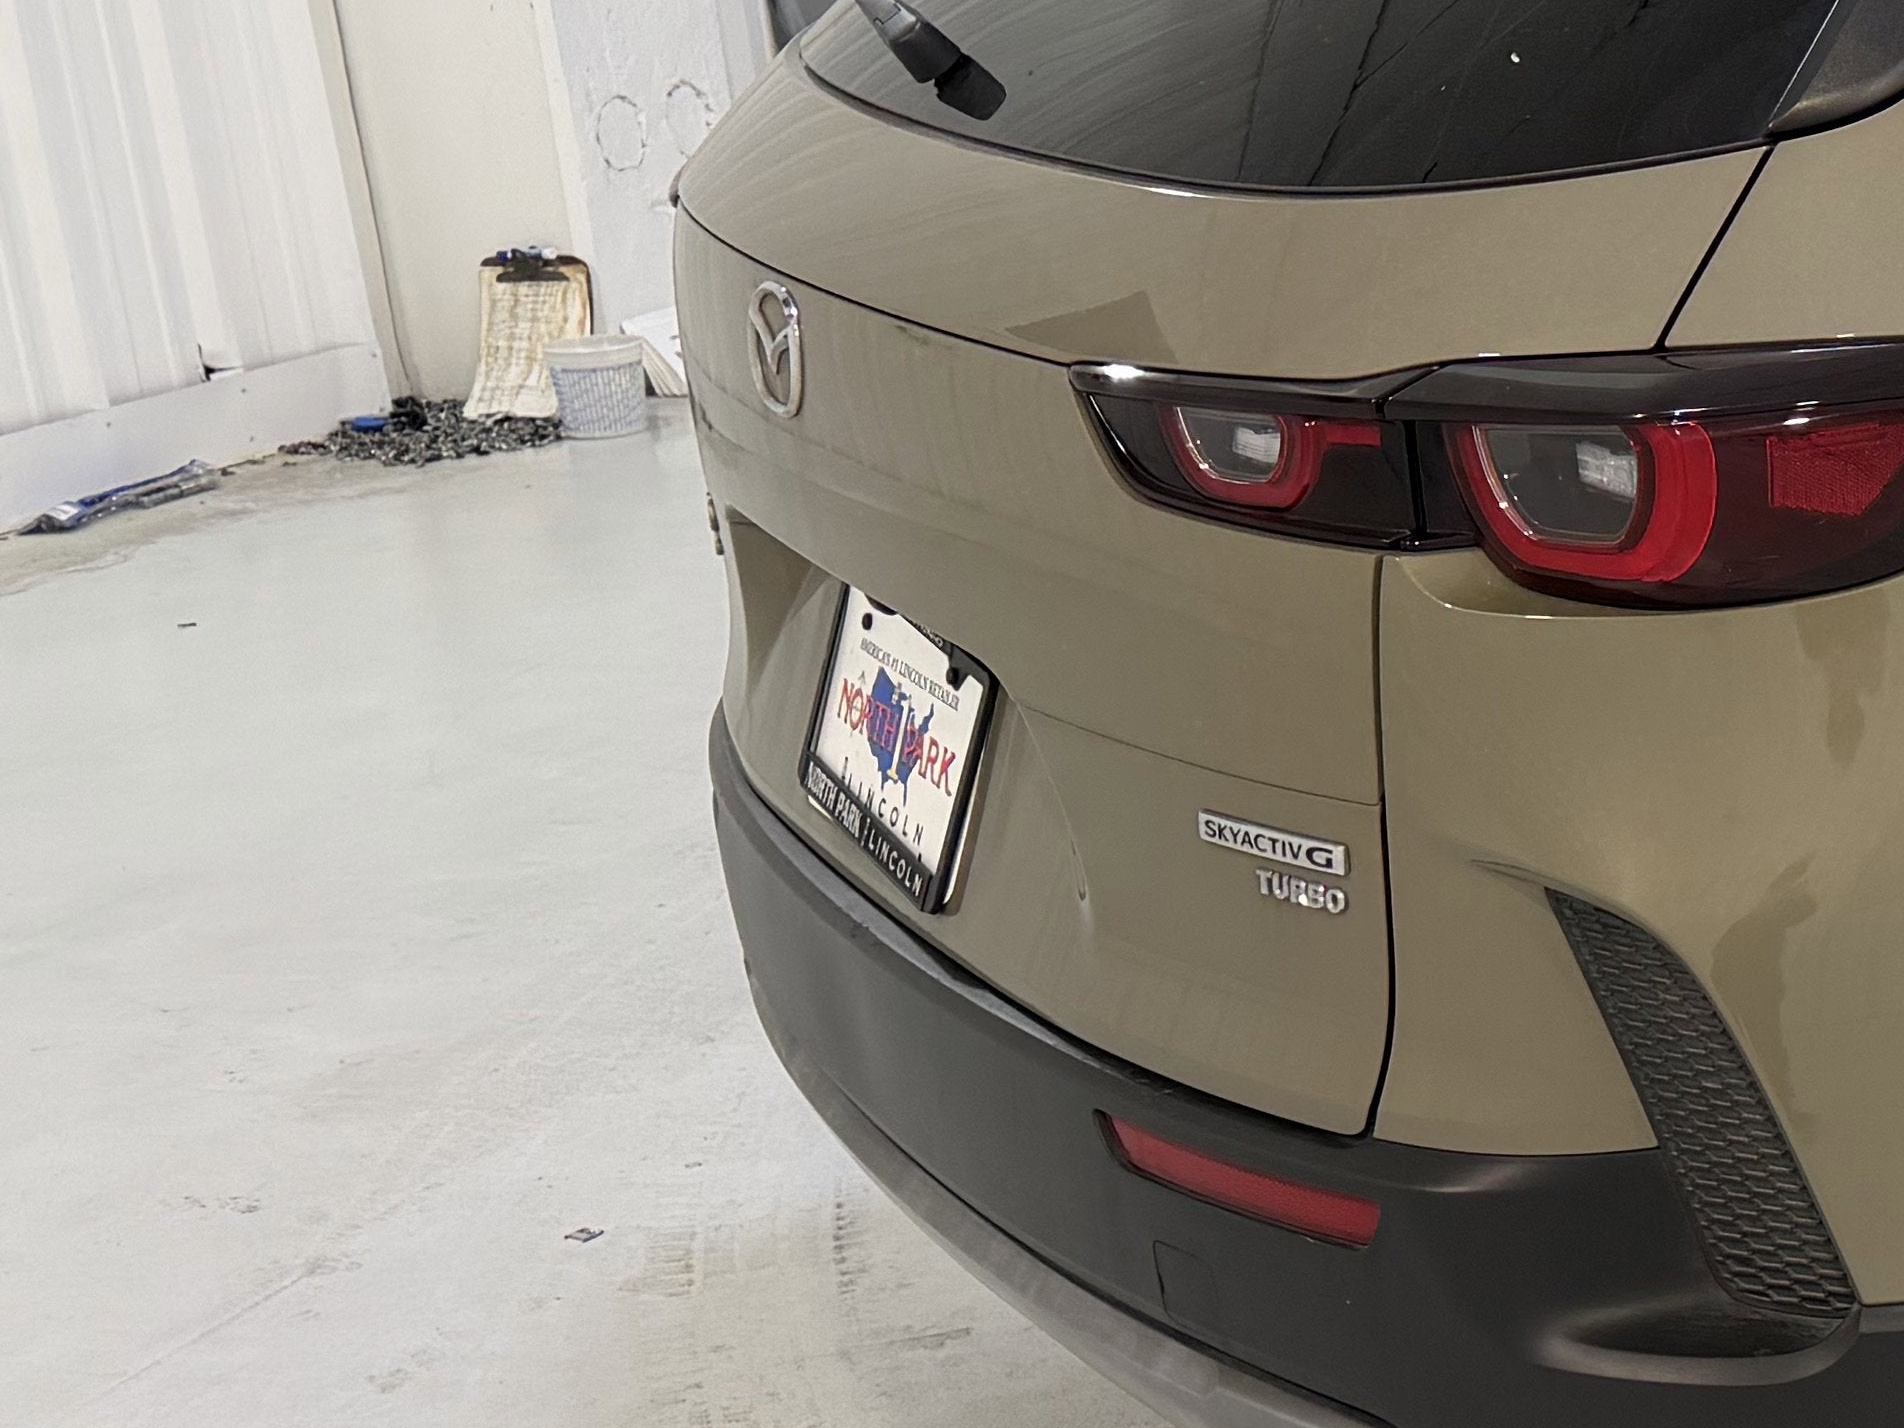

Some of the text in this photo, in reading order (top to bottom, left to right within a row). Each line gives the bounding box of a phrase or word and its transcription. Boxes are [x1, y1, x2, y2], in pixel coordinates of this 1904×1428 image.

[898, 660, 929, 691] LINCOLN
[837, 678, 956, 797] NORTH PARK
[804, 760, 924, 898] NORTH PARK LINCOLN
[847, 772, 924, 847] LINCOLN
[1256, 868, 1346, 914] TURBO
